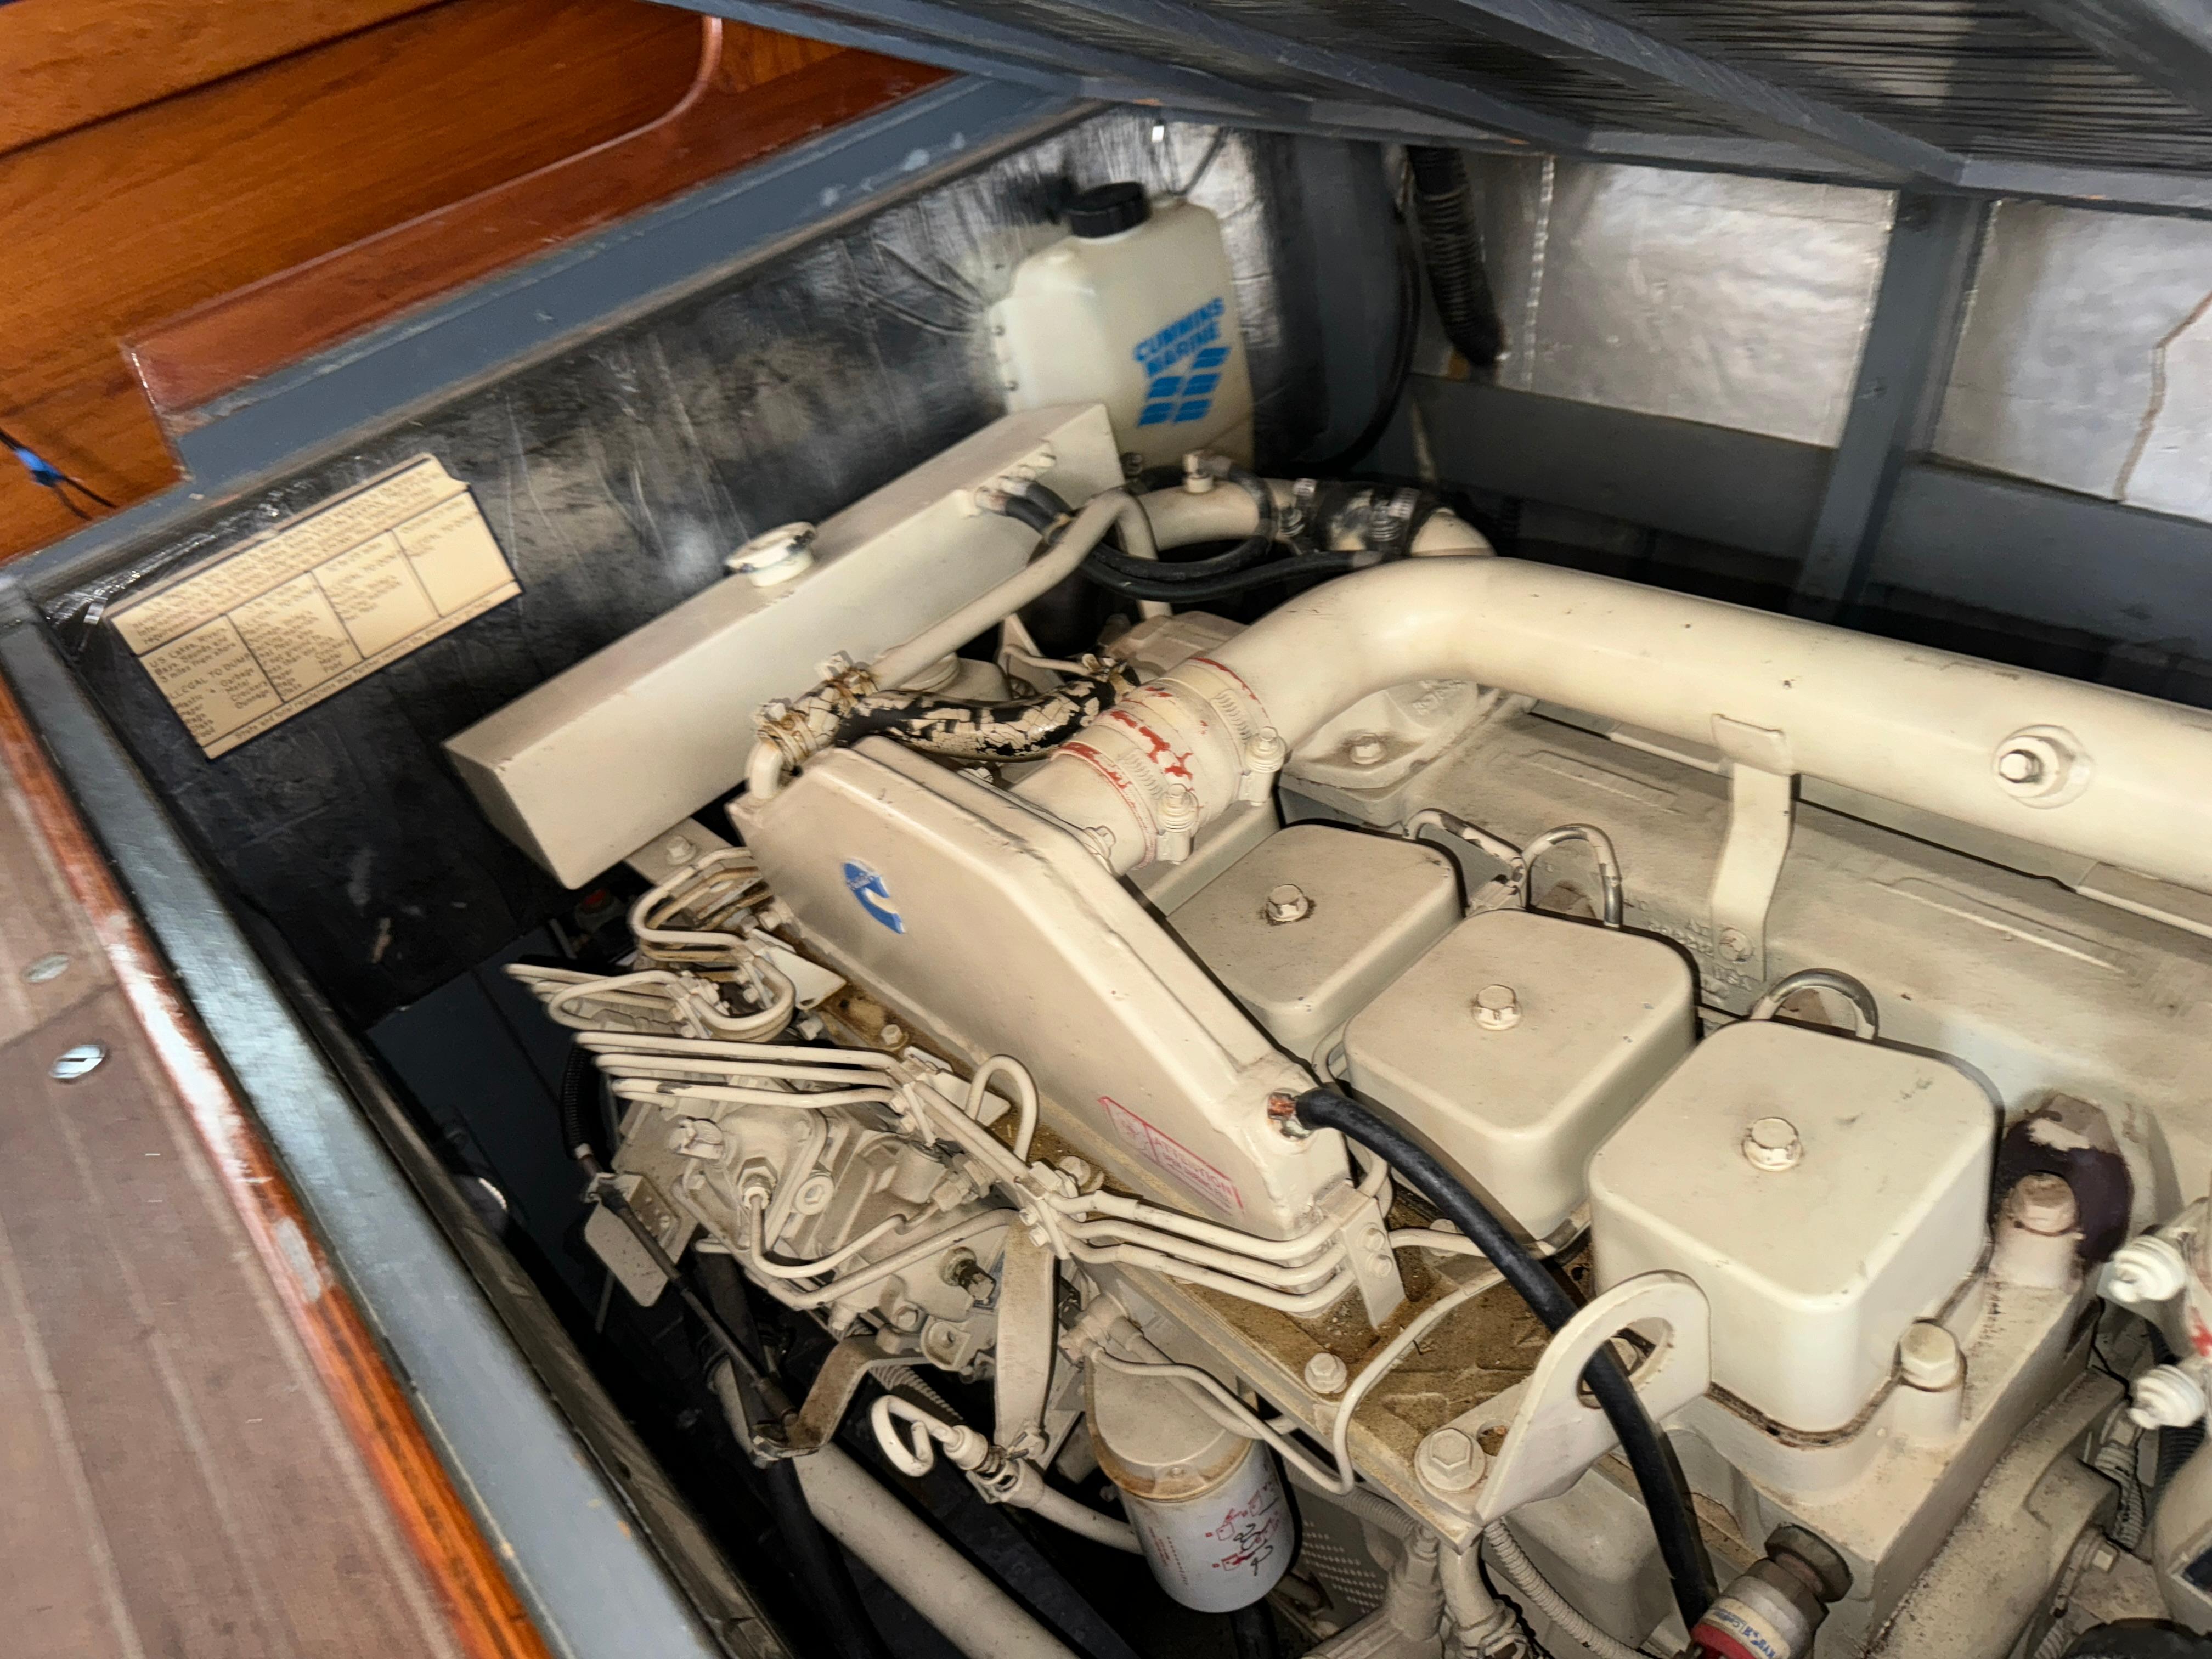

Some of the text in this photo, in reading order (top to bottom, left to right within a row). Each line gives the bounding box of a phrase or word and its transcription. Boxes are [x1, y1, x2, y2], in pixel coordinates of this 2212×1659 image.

[1134, 297, 1224, 361] CUMMINS
[1147, 321, 1220, 377] MARINE
[168, 663, 192, 679] miles
[190, 652, 213, 668] from
[207, 667, 224, 679] TO
[222, 651, 252, 672] DUMP
[219, 665, 256, 689] Garbage
[224, 678, 250, 695] Metal
